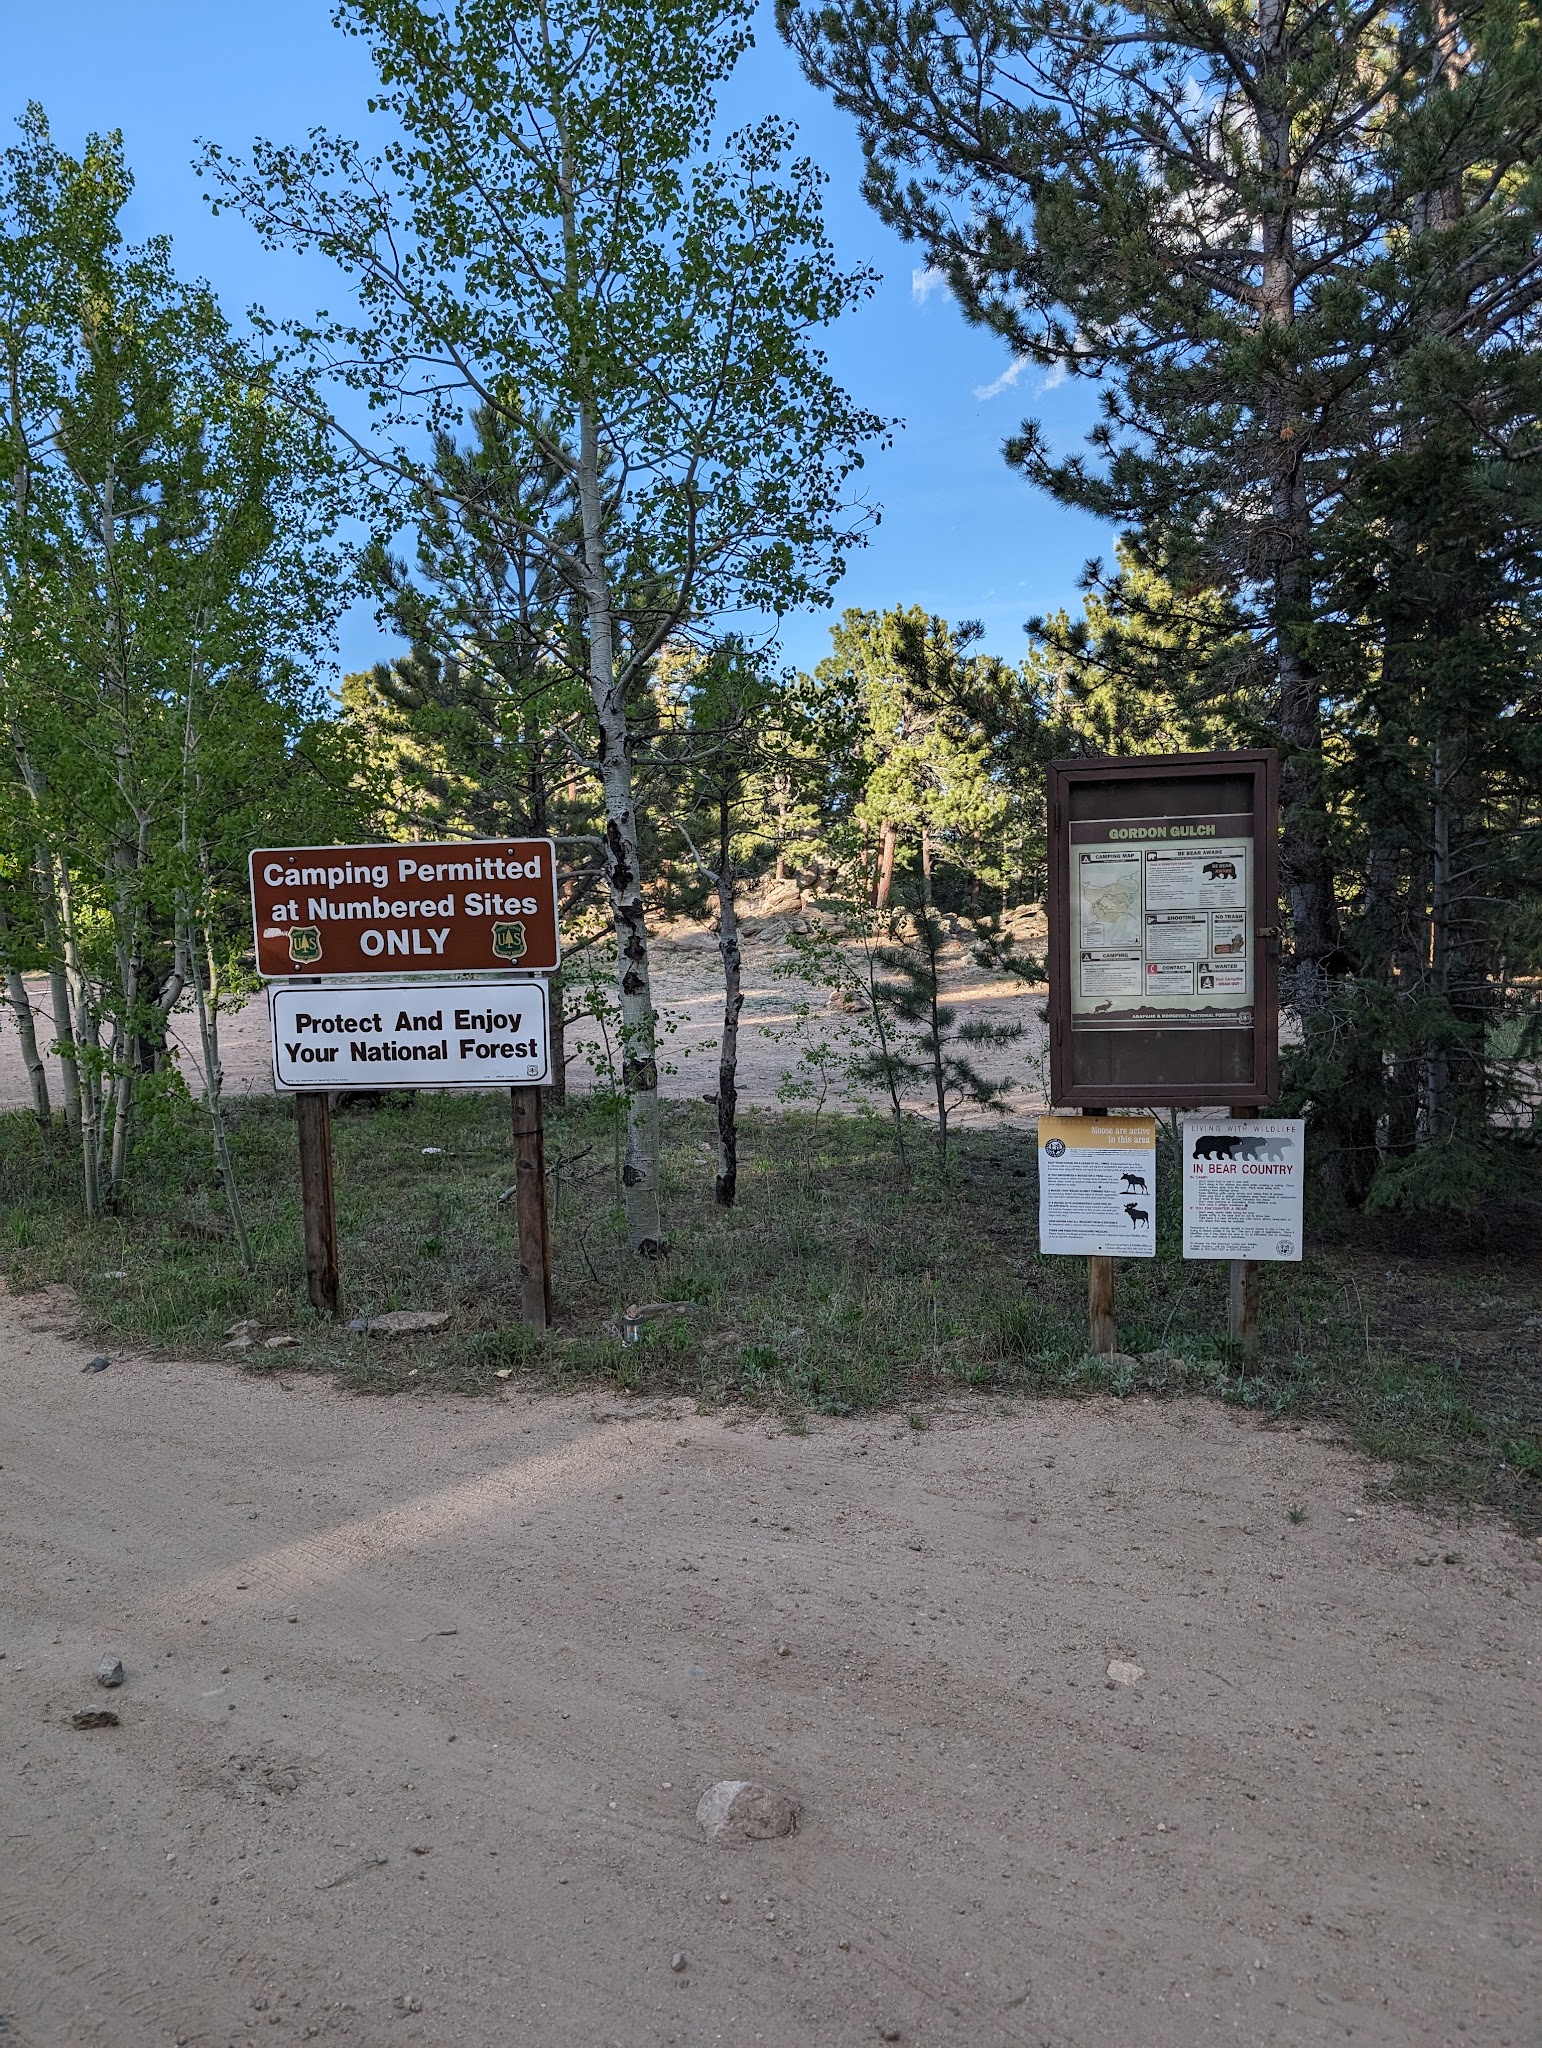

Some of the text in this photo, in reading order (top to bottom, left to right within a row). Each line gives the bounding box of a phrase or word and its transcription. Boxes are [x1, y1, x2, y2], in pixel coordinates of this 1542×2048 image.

[1109, 824, 1216, 840] GORDON GULCH
[263, 855, 541, 889] Camping Permitted
[271, 892, 538, 922] at Numbered Sites
[360, 927, 451, 957] ONLY
[295, 1008, 522, 1034] Protect And Enjoy
[284, 1038, 538, 1062] Your National Forest
[1091, 1126, 1151, 1135] Moose are active
[1108, 1136, 1116, 1144] in
[1117, 1135, 1132, 1144] this
[1193, 1163, 1294, 1175] IN BEAR COUNTRY
